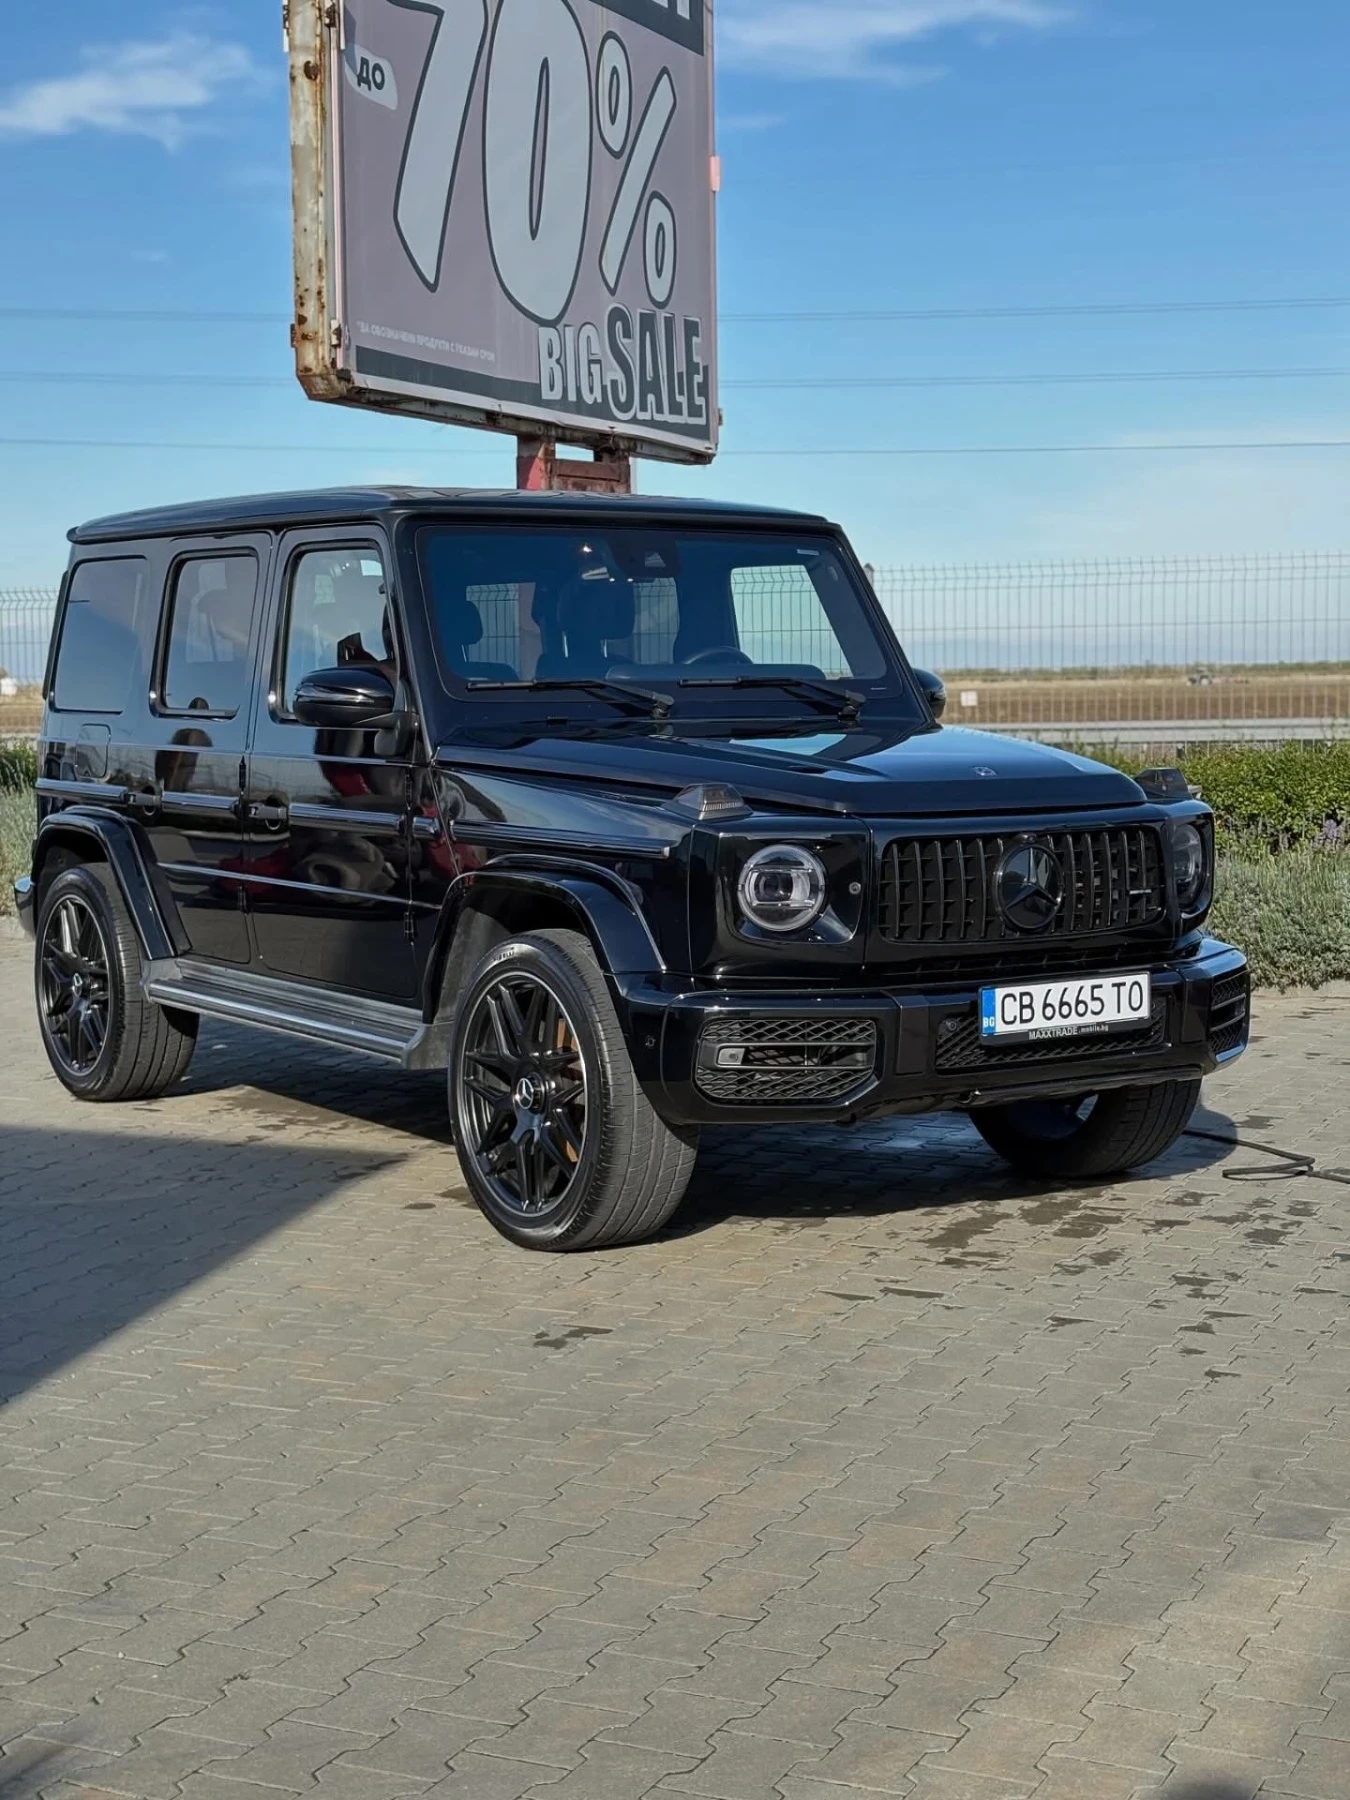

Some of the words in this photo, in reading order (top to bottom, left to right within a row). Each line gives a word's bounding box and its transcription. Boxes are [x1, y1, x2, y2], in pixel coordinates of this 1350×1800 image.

[387, 0, 677, 326] 70%
[538, 322, 603, 404] BIG
[606, 303, 707, 425] SALE
[982, 1017, 995, 1028] BG
[1000, 991, 1035, 1026] CB
[1042, 983, 1105, 1021] 6665
